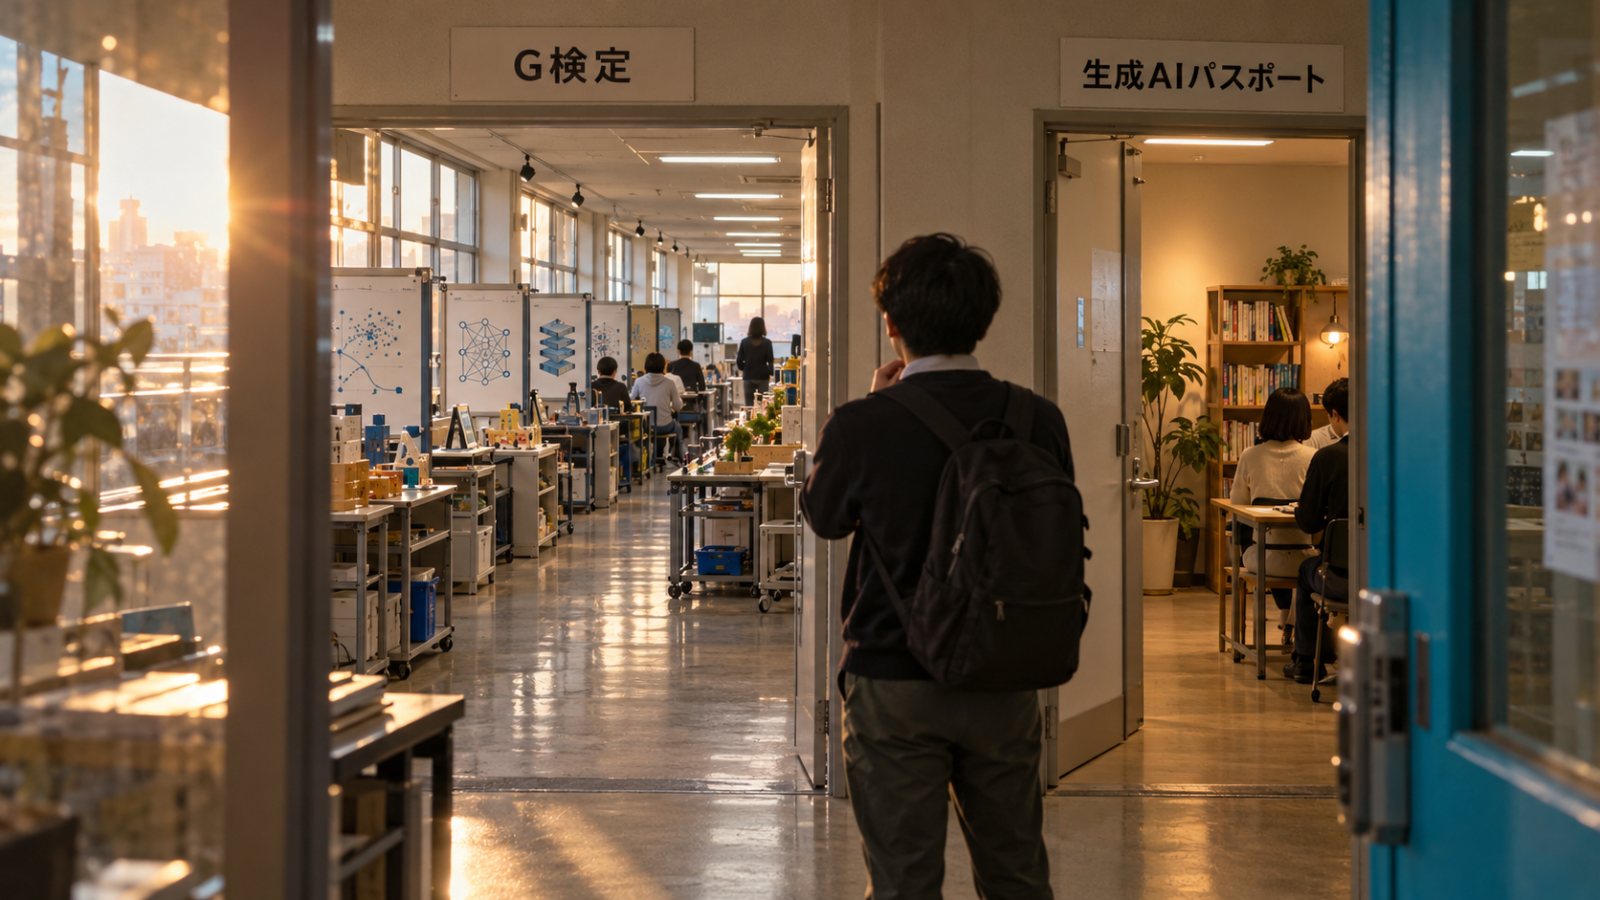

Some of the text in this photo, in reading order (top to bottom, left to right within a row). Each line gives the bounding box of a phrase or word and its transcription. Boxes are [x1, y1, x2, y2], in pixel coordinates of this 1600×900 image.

[514, 46, 631, 84] G検定
[1082, 58, 1325, 93] 生成AIパスポート
